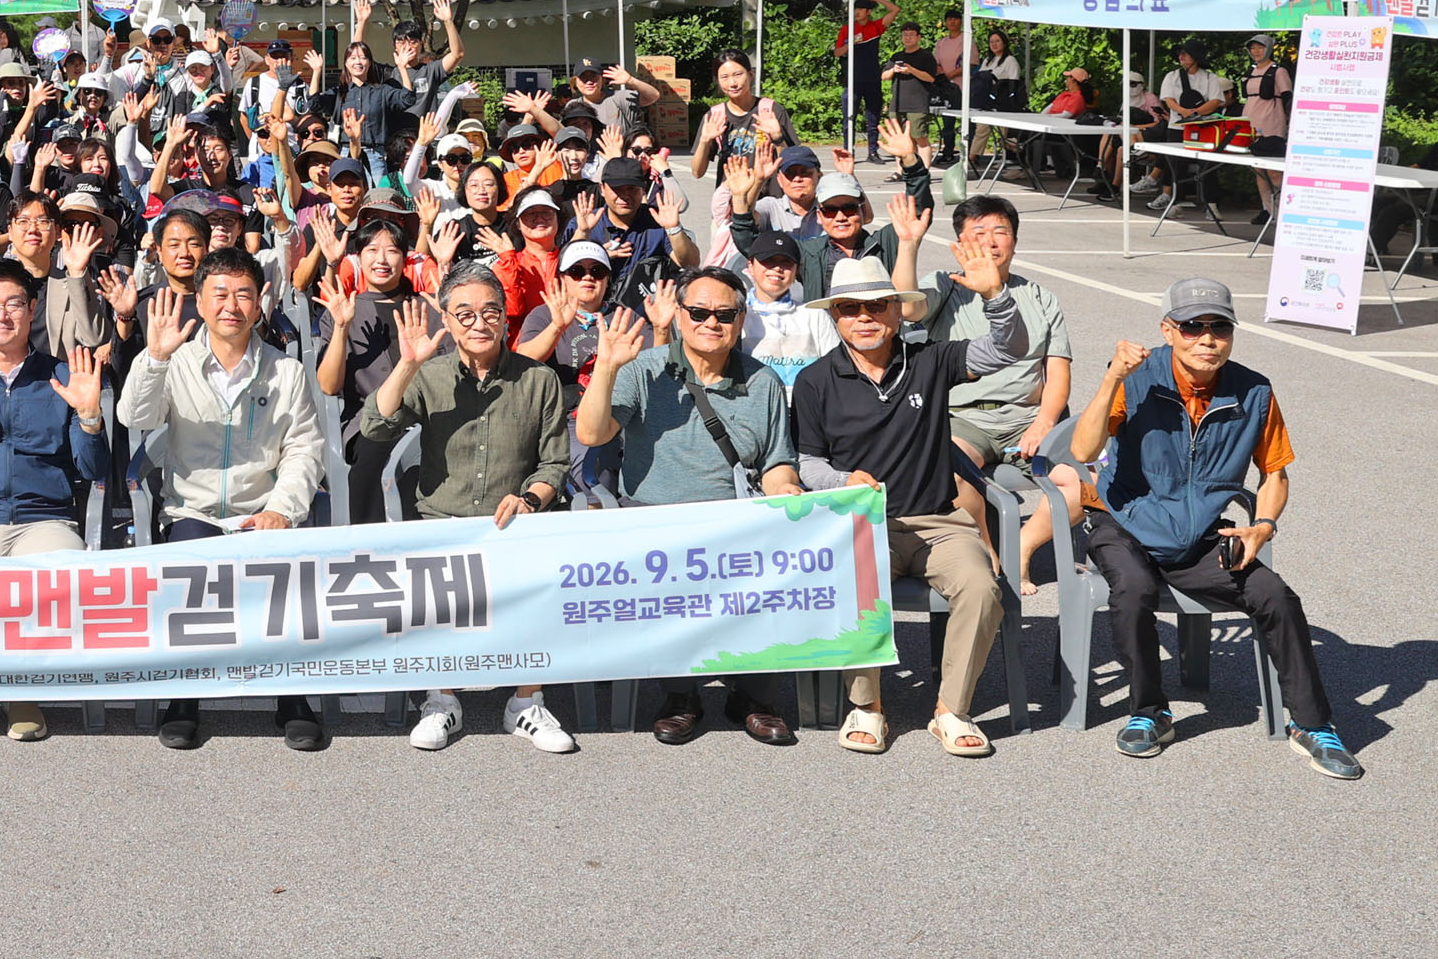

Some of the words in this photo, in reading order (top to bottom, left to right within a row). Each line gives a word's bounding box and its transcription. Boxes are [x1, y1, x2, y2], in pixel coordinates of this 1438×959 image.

[1343, 30, 1362, 39] PLAY
[1340, 40, 1358, 48] PLUS
[1305, 50, 1384, 62] 건강생활실천지원금제
[1192, 288, 1219, 298] ROTC
[559, 561, 638, 589] 2026.
[645, 549, 677, 584] 9.
[772, 547, 834, 575] 9:00
[562, 593, 713, 625] 원주얼교육관
[719, 586, 836, 617] 제2주차장
[105, 666, 220, 682] 원주시걷기협회,
[227, 657, 387, 679] 맨발걷기국민운동본부
[393, 651, 552, 674] 원주지회(원주맨사모)
